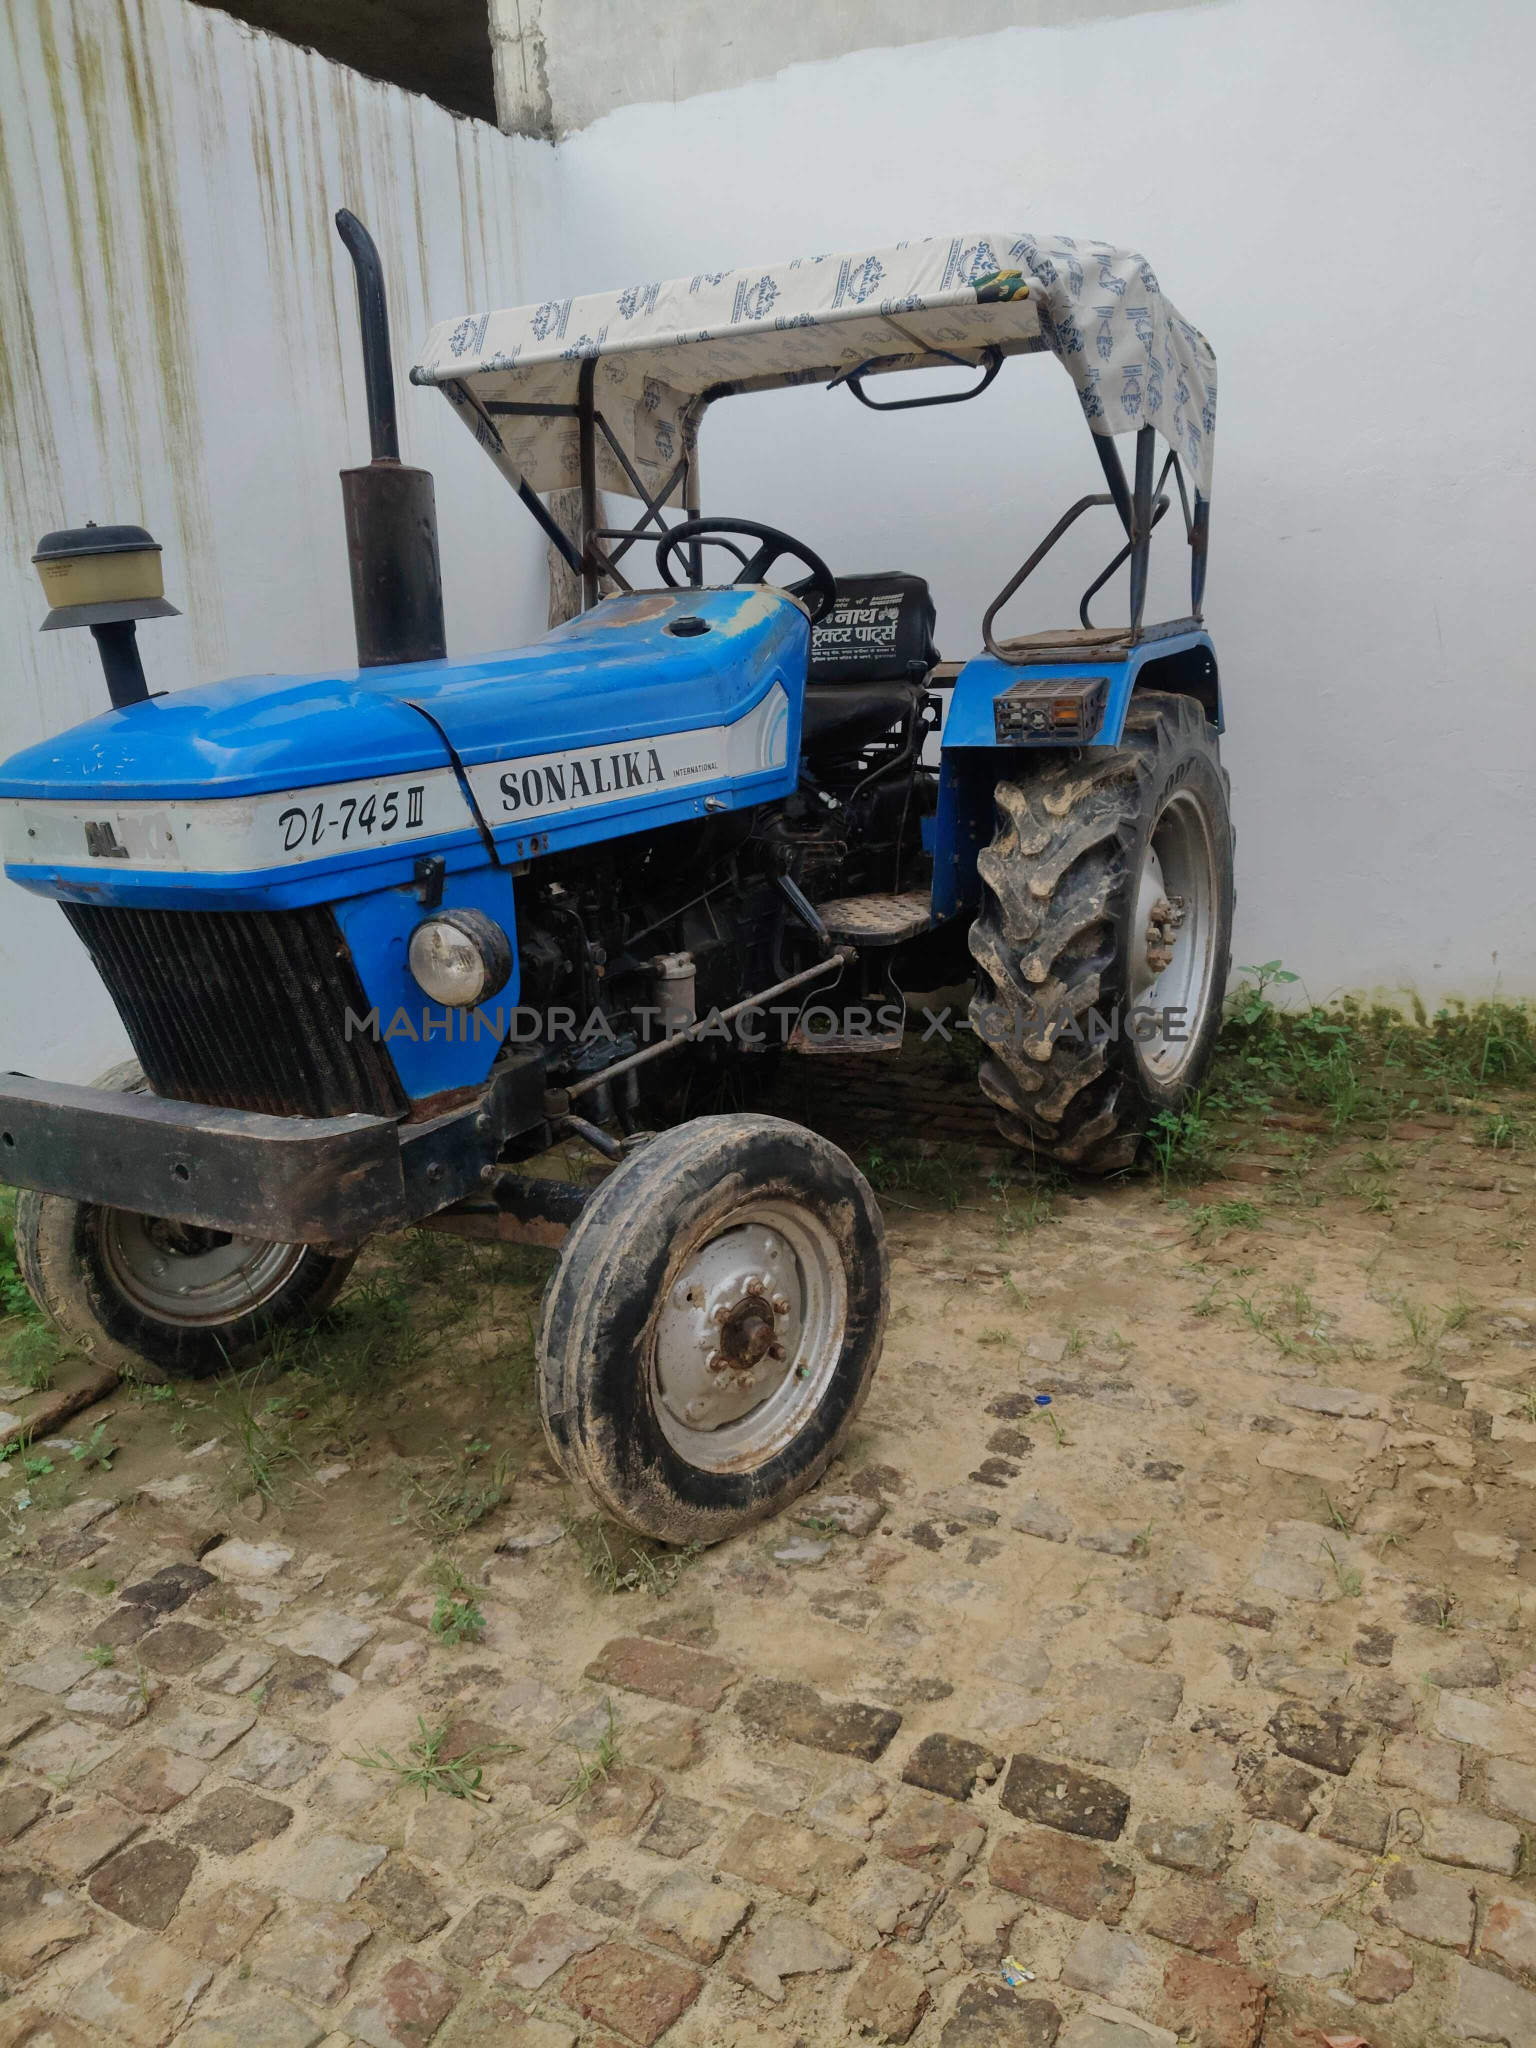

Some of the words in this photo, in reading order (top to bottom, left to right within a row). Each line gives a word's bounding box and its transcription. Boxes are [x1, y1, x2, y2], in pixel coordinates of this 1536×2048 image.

[857, 255, 876, 304] SONALIKA
[835, 608, 879, 625] नाथ
[500, 749, 666, 811] SONALIKA
[673, 762, 718, 778] INTERNATIONAL
